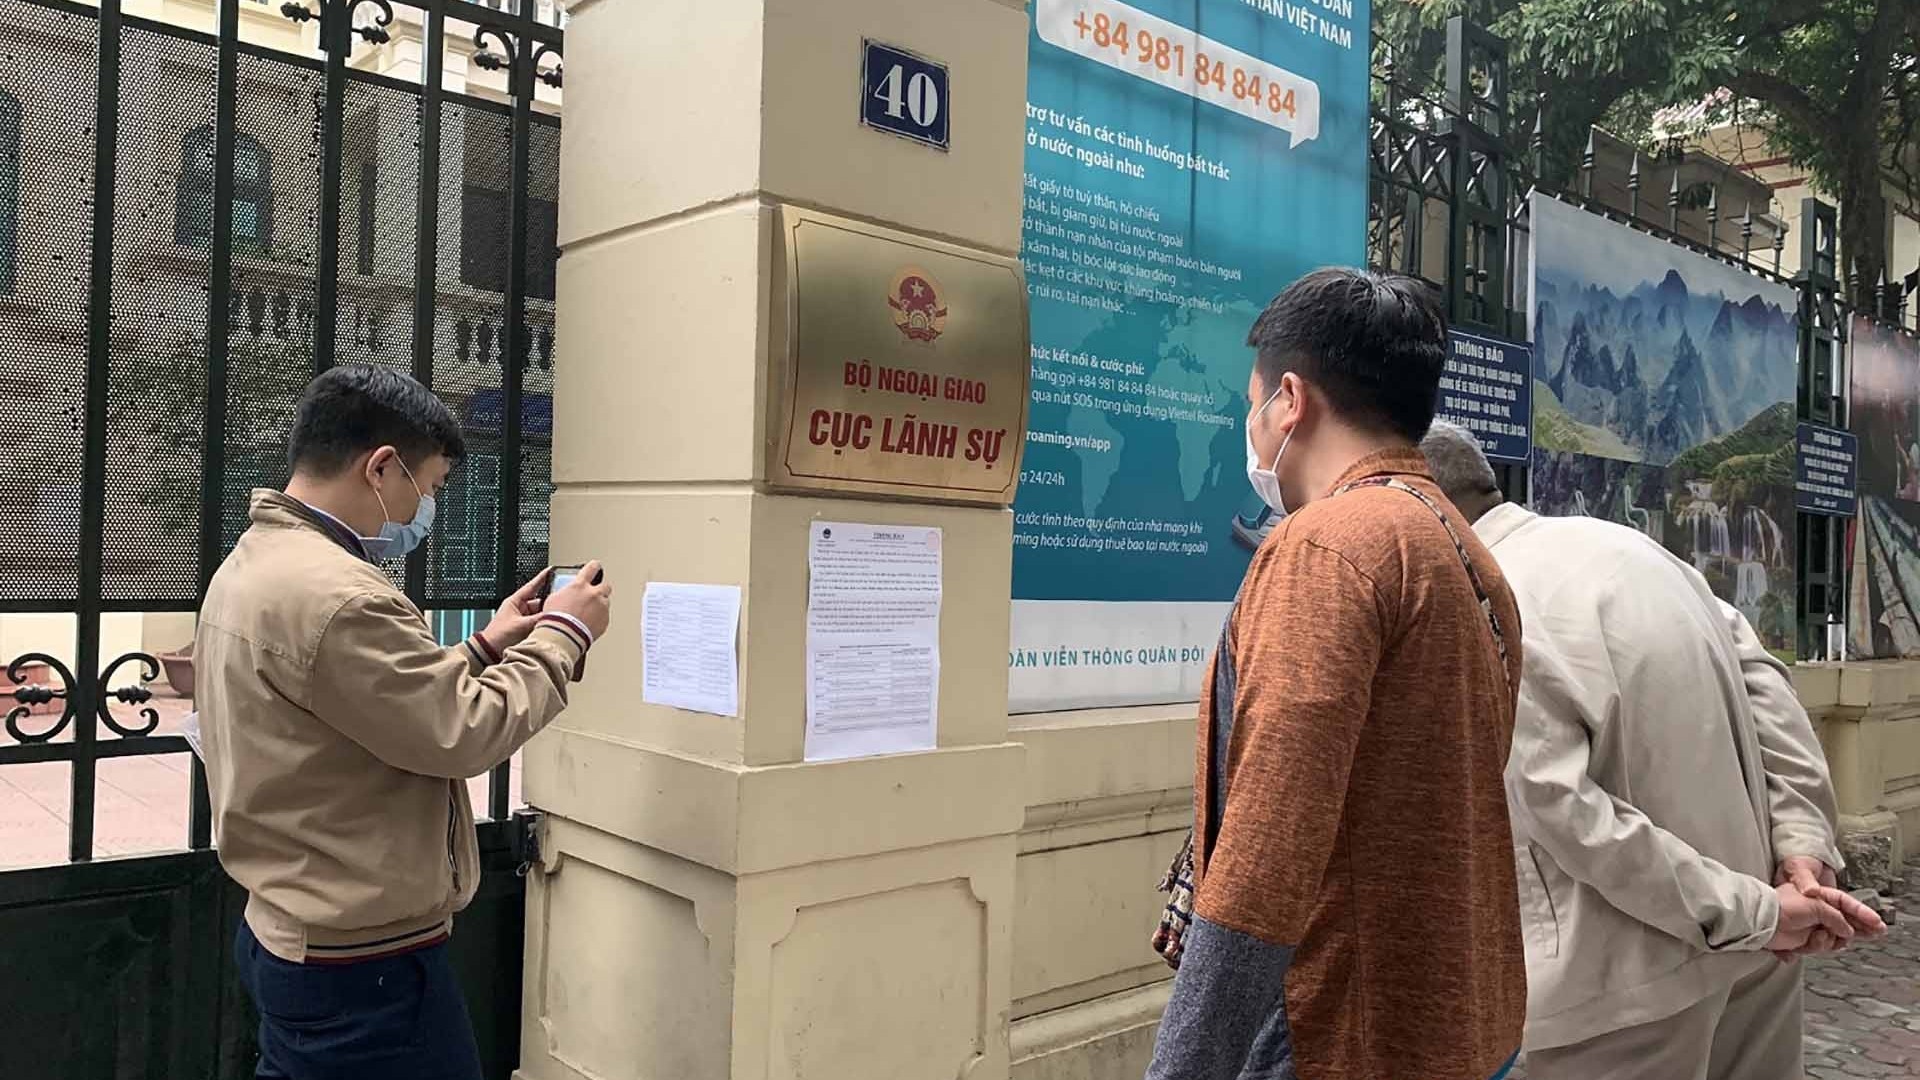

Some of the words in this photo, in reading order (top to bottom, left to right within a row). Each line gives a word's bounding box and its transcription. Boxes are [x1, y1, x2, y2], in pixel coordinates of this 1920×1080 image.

[1286, 3, 1317, 35] VIỆT
[1319, 18, 1351, 50] NAM
[1073, 11, 1129, 55] +84
[1137, 30, 1184, 77] 981
[1194, 53, 1226, 92] 84
[1232, 68, 1262, 107] 84
[1268, 83, 1297, 119] 84
[874, 64, 938, 127] 40
[1026, 102, 1047, 126] trợ
[1049, 109, 1065, 127] tư
[1067, 116, 1091, 136] vấn
[1094, 124, 1115, 144] các
[1117, 131, 1143, 153] tình
[1186, 152, 1206, 172] bất
[1027, 127, 1037, 146] ở
[1039, 135, 1073, 157] nước
[1076, 147, 1114, 170] ngoài
[1039, 179, 1061, 198] giấy
[1062, 206, 1088, 222] giam
[1034, 220, 1065, 238] thành
[1030, 343, 1051, 361] hức
[1052, 347, 1071, 364] kết
[1071, 350, 1089, 368] nối
[1090, 354, 1099, 368] &
[1100, 357, 1125, 373] cước
[1454, 340, 1484, 359] THÔNG
[1486, 346, 1504, 363] BÁO
[844, 360, 871, 394] BỘ
[878, 367, 938, 402] NGOẠI
[944, 377, 987, 404] GIAO
[1077, 374, 1097, 389] +84
[1098, 375, 1115, 391] 981
[1031, 389, 1052, 404] qua
[1053, 391, 1072, 406] nút
[1072, 392, 1093, 408] SOS
[1094, 397, 1121, 415] trong
[808, 409, 873, 455] CỤC
[880, 413, 958, 459] LÃNH
[964, 427, 1007, 470] SỰ
[1029, 469, 1065, 485] 24/24h
[1015, 511, 1041, 526] cước
[1062, 513, 1085, 528] theo
[1012, 531, 1040, 549] ming
[1126, 537, 1145, 551] bao
[1044, 644, 1078, 666] VIỄN
[1083, 647, 1133, 666] THÔNG
[1138, 645, 1176, 665] QUÂN
[1182, 643, 1204, 666] ĐỘI
